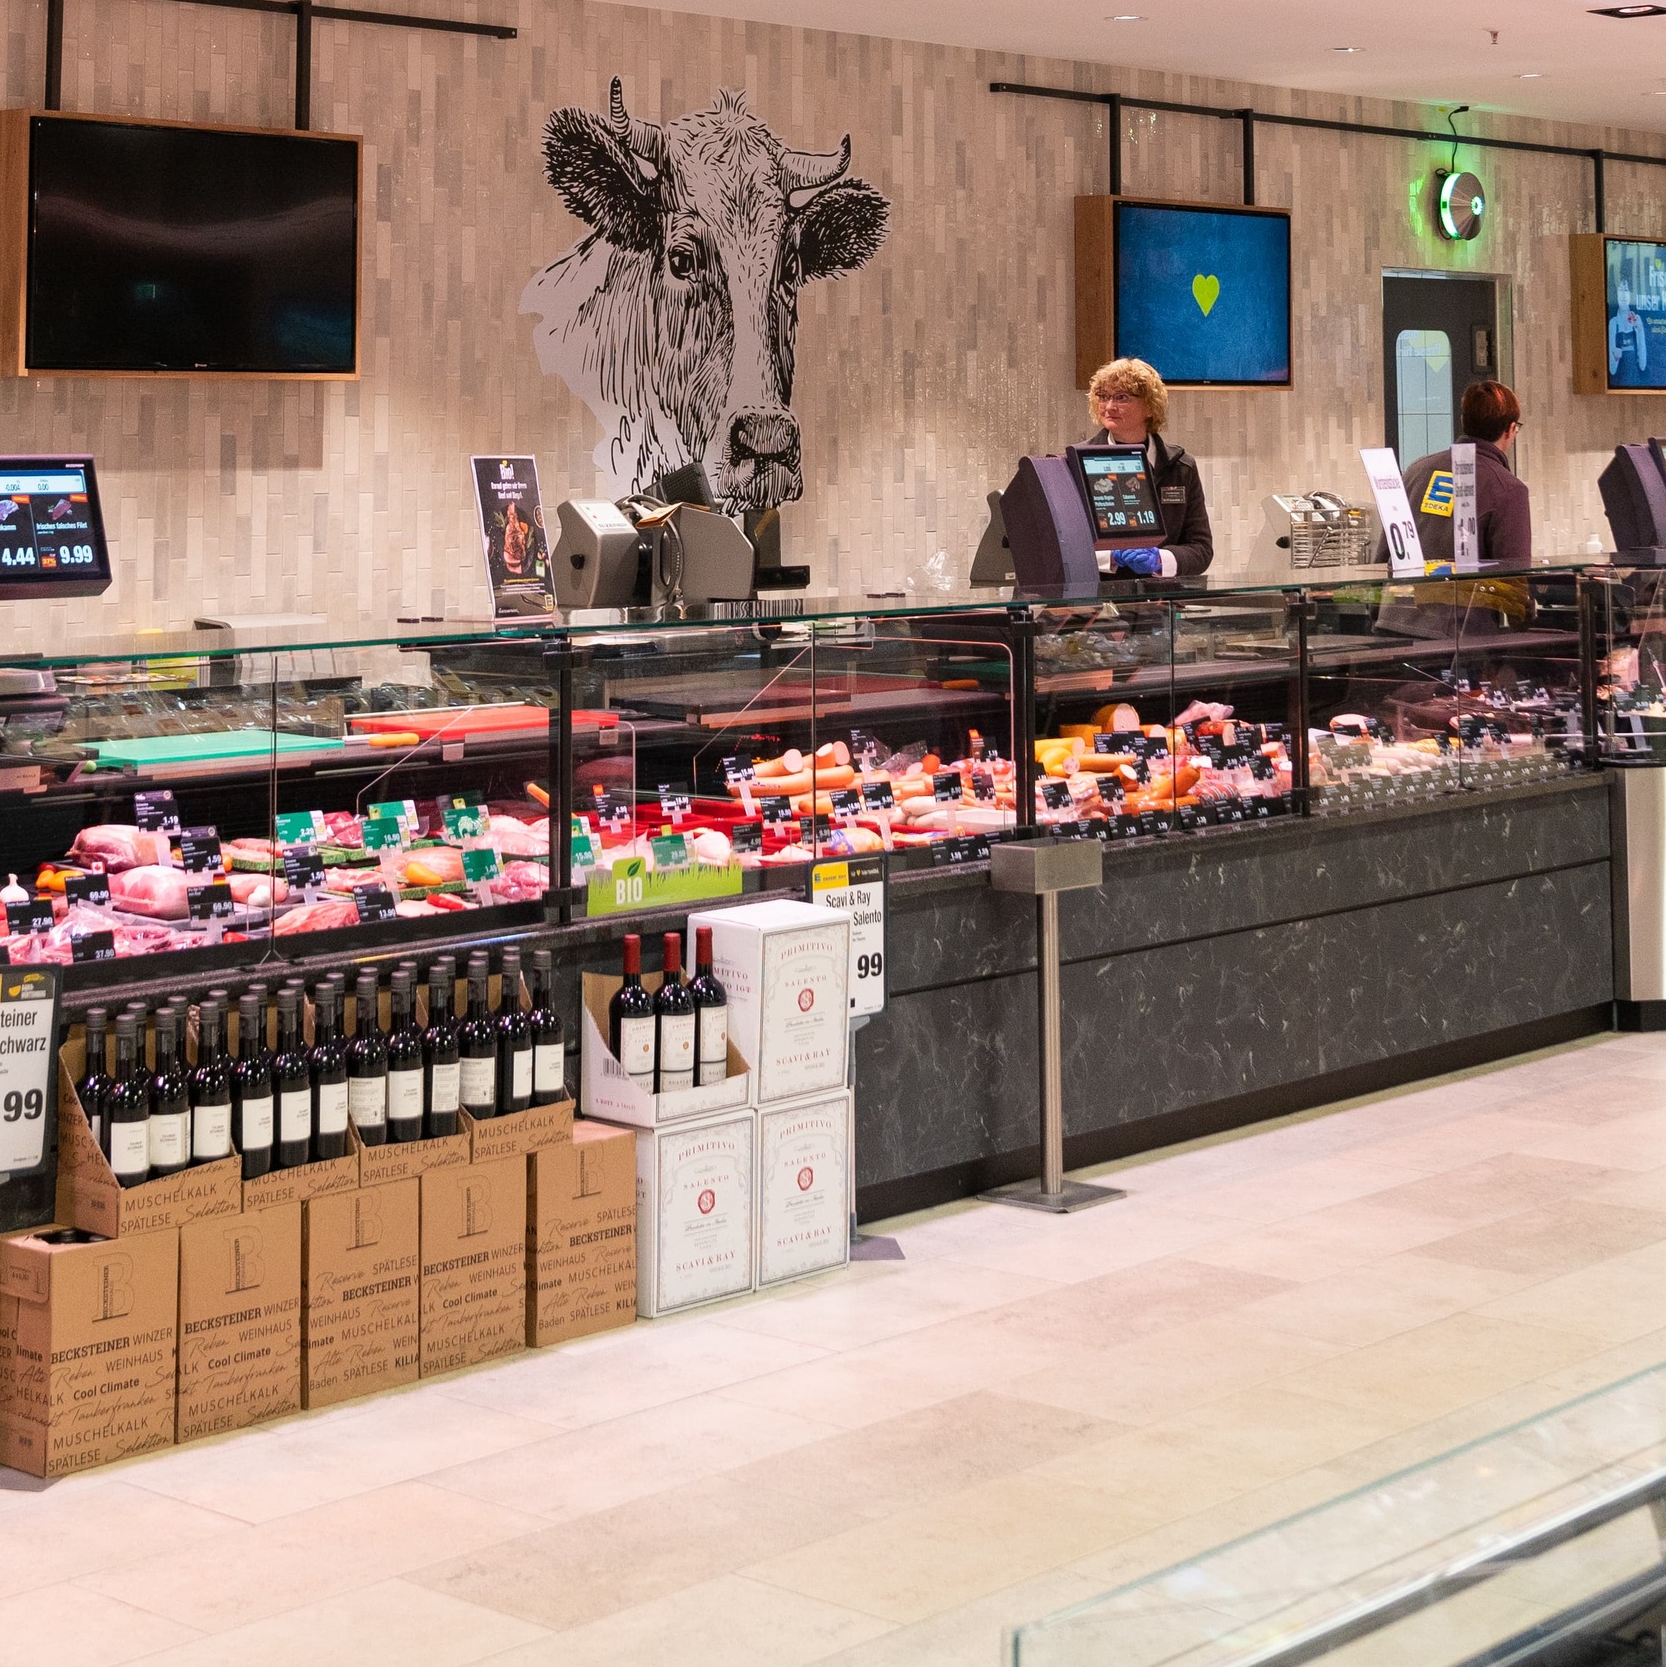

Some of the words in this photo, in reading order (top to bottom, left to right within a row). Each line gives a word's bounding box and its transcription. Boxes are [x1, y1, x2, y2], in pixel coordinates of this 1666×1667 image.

[1, 546, 36, 567] 4.44
[59, 544, 94, 565] 9.99
[616, 877, 643, 905] BIO
[825, 892, 847, 909] Scavi
[849, 891, 855, 906] &
[857, 890, 871, 907] Ray
[853, 910, 882, 926] Salento
[780, 942, 834, 960] PRIMITIVO
[784, 974, 828, 989] SALENTO
[478, 1115, 555, 1139] MUSCHELKALK
[779, 1119, 833, 1140] PRIMITIVO
[367, 1137, 448, 1162] MUSCHELKALK
[474, 1140, 517, 1159] SPÄTLESE
[520, 1129, 574, 1153] Selektion
[678, 1141, 736, 1162] PRIMITIVO
[363, 1162, 408, 1182] SPÄTLESE
[411, 1149, 468, 1175] Selektion
[783, 1152, 827, 1168] SALENTO
[251, 1158, 337, 1188] MUSCHELKALK
[683, 1175, 730, 1190] SALENTO
[124, 1184, 217, 1212] MUSCHELKALK
[247, 1186, 294, 1208] SPÄTLESE
[298, 1174, 359, 1200] Selektion
[120, 1212, 171, 1234] SPÄTLESE
[177, 1198, 241, 1225] Selektion
[596, 1204, 637, 1223] SPÄTLESE
[569, 1223, 633, 1248] BECKSTEINER
[372, 1253, 418, 1276] SPÄTLESE
[423, 1251, 490, 1277] BECKSTEINER
[490, 1243, 524, 1260] WINZER
[539, 1252, 586, 1274] WEINHAUS
[468, 1262, 517, 1284] WEINHAUS
[342, 1275, 412, 1302] BECKSTEINER
[442, 1295, 463, 1310] Cool
[464, 1286, 498, 1305] Climate
[184, 1307, 262, 1335] BECKSTEINER
[263, 1298, 300, 1317] WINZER
[309, 1306, 361, 1331] WEINHAUS
[538, 1315, 565, 1331] Baden
[569, 1303, 611, 1324] SPÄTLESE
[238, 1319, 293, 1343] WEINHAUS
[426, 1324, 505, 1353] MUSCHELKALK
[50, 1336, 131, 1365] BECKSTEINER
[131, 1327, 173, 1346] WINZER
[207, 1356, 231, 1370] Cool
[233, 1346, 272, 1365] Climate
[105, 1348, 164, 1373] WEINHAUS
[423, 1350, 467, 1374] SPÄTLESE
[308, 1374, 338, 1392] Baden
[343, 1357, 389, 1383] SPÄTLESE
[73, 1387, 98, 1401] Cool
[100, 1377, 140, 1395] Climate
[188, 1384, 279, 1417] MUSCHELKALK
[183, 1415, 234, 1439] SPÄTLESE
[236, 1400, 300, 1428] Selektion
[53, 1417, 149, 1450] MUSCHELKALK
[48, 1448, 102, 1473] SPÄTLESE
[105, 1433, 173, 1462] Selektion
